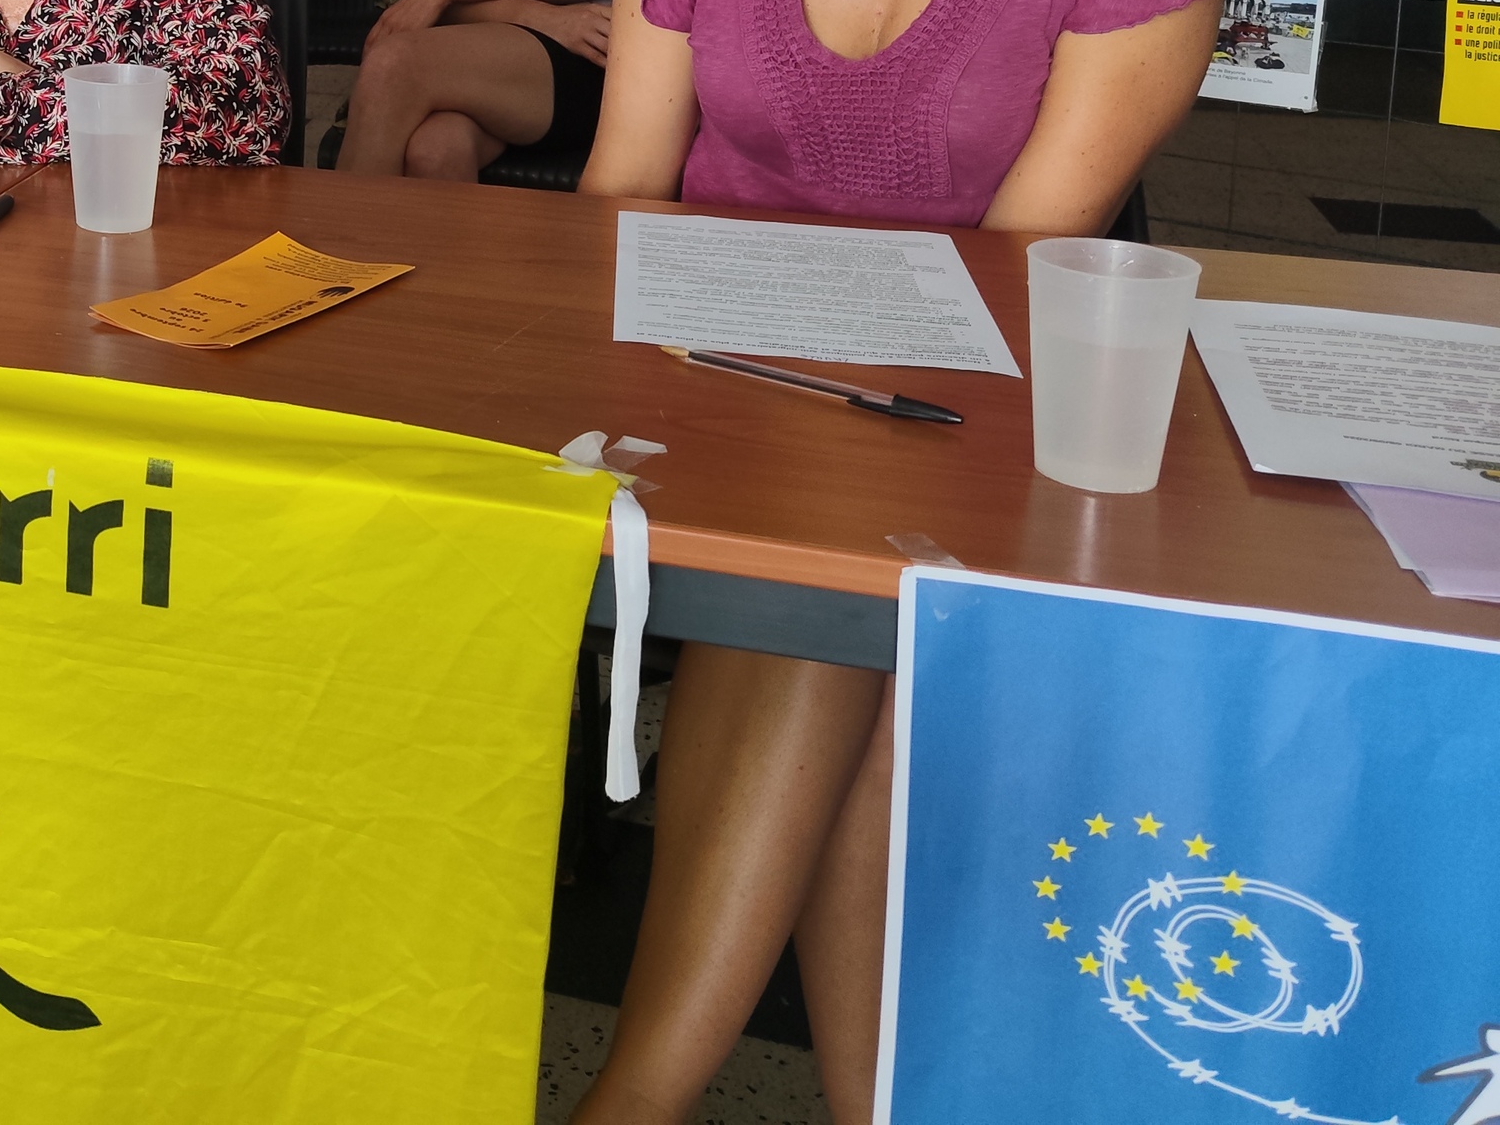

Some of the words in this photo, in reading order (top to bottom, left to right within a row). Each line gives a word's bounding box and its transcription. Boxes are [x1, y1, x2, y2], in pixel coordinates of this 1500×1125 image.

[1467, 10, 1474, 20] la
[1466, 24, 1474, 34] le
[1476, 25, 1496, 35] droit
[1466, 39, 1480, 48] une
[1464, 50, 1472, 58] la
